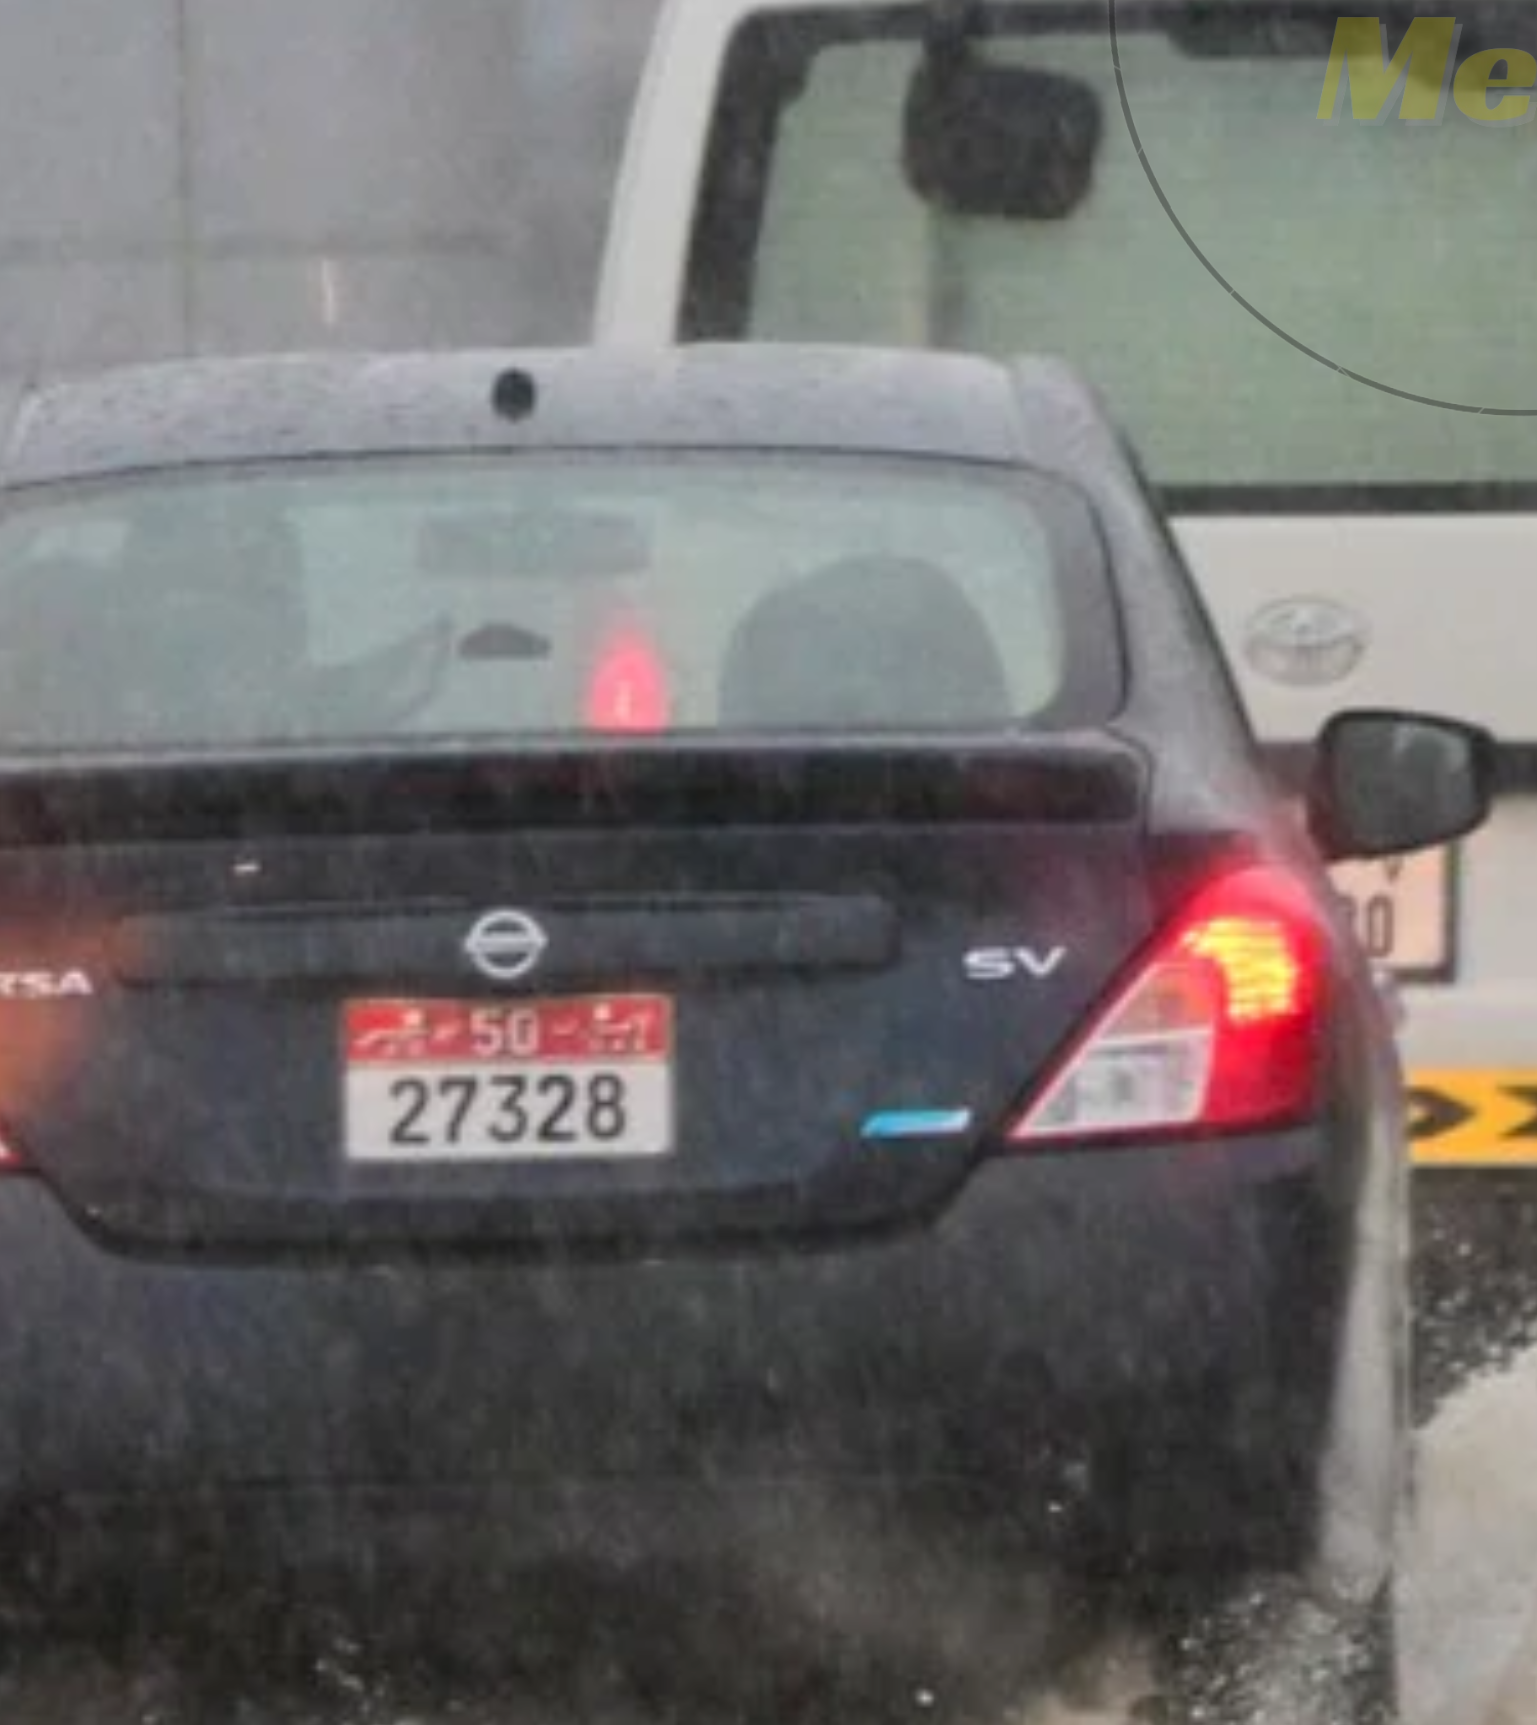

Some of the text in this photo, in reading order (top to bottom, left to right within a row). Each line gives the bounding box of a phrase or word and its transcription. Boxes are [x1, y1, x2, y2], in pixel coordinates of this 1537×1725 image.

[963, 944, 1066, 981] SV
[469, 1006, 539, 1055] 50
[388, 1073, 626, 1145] 27328
